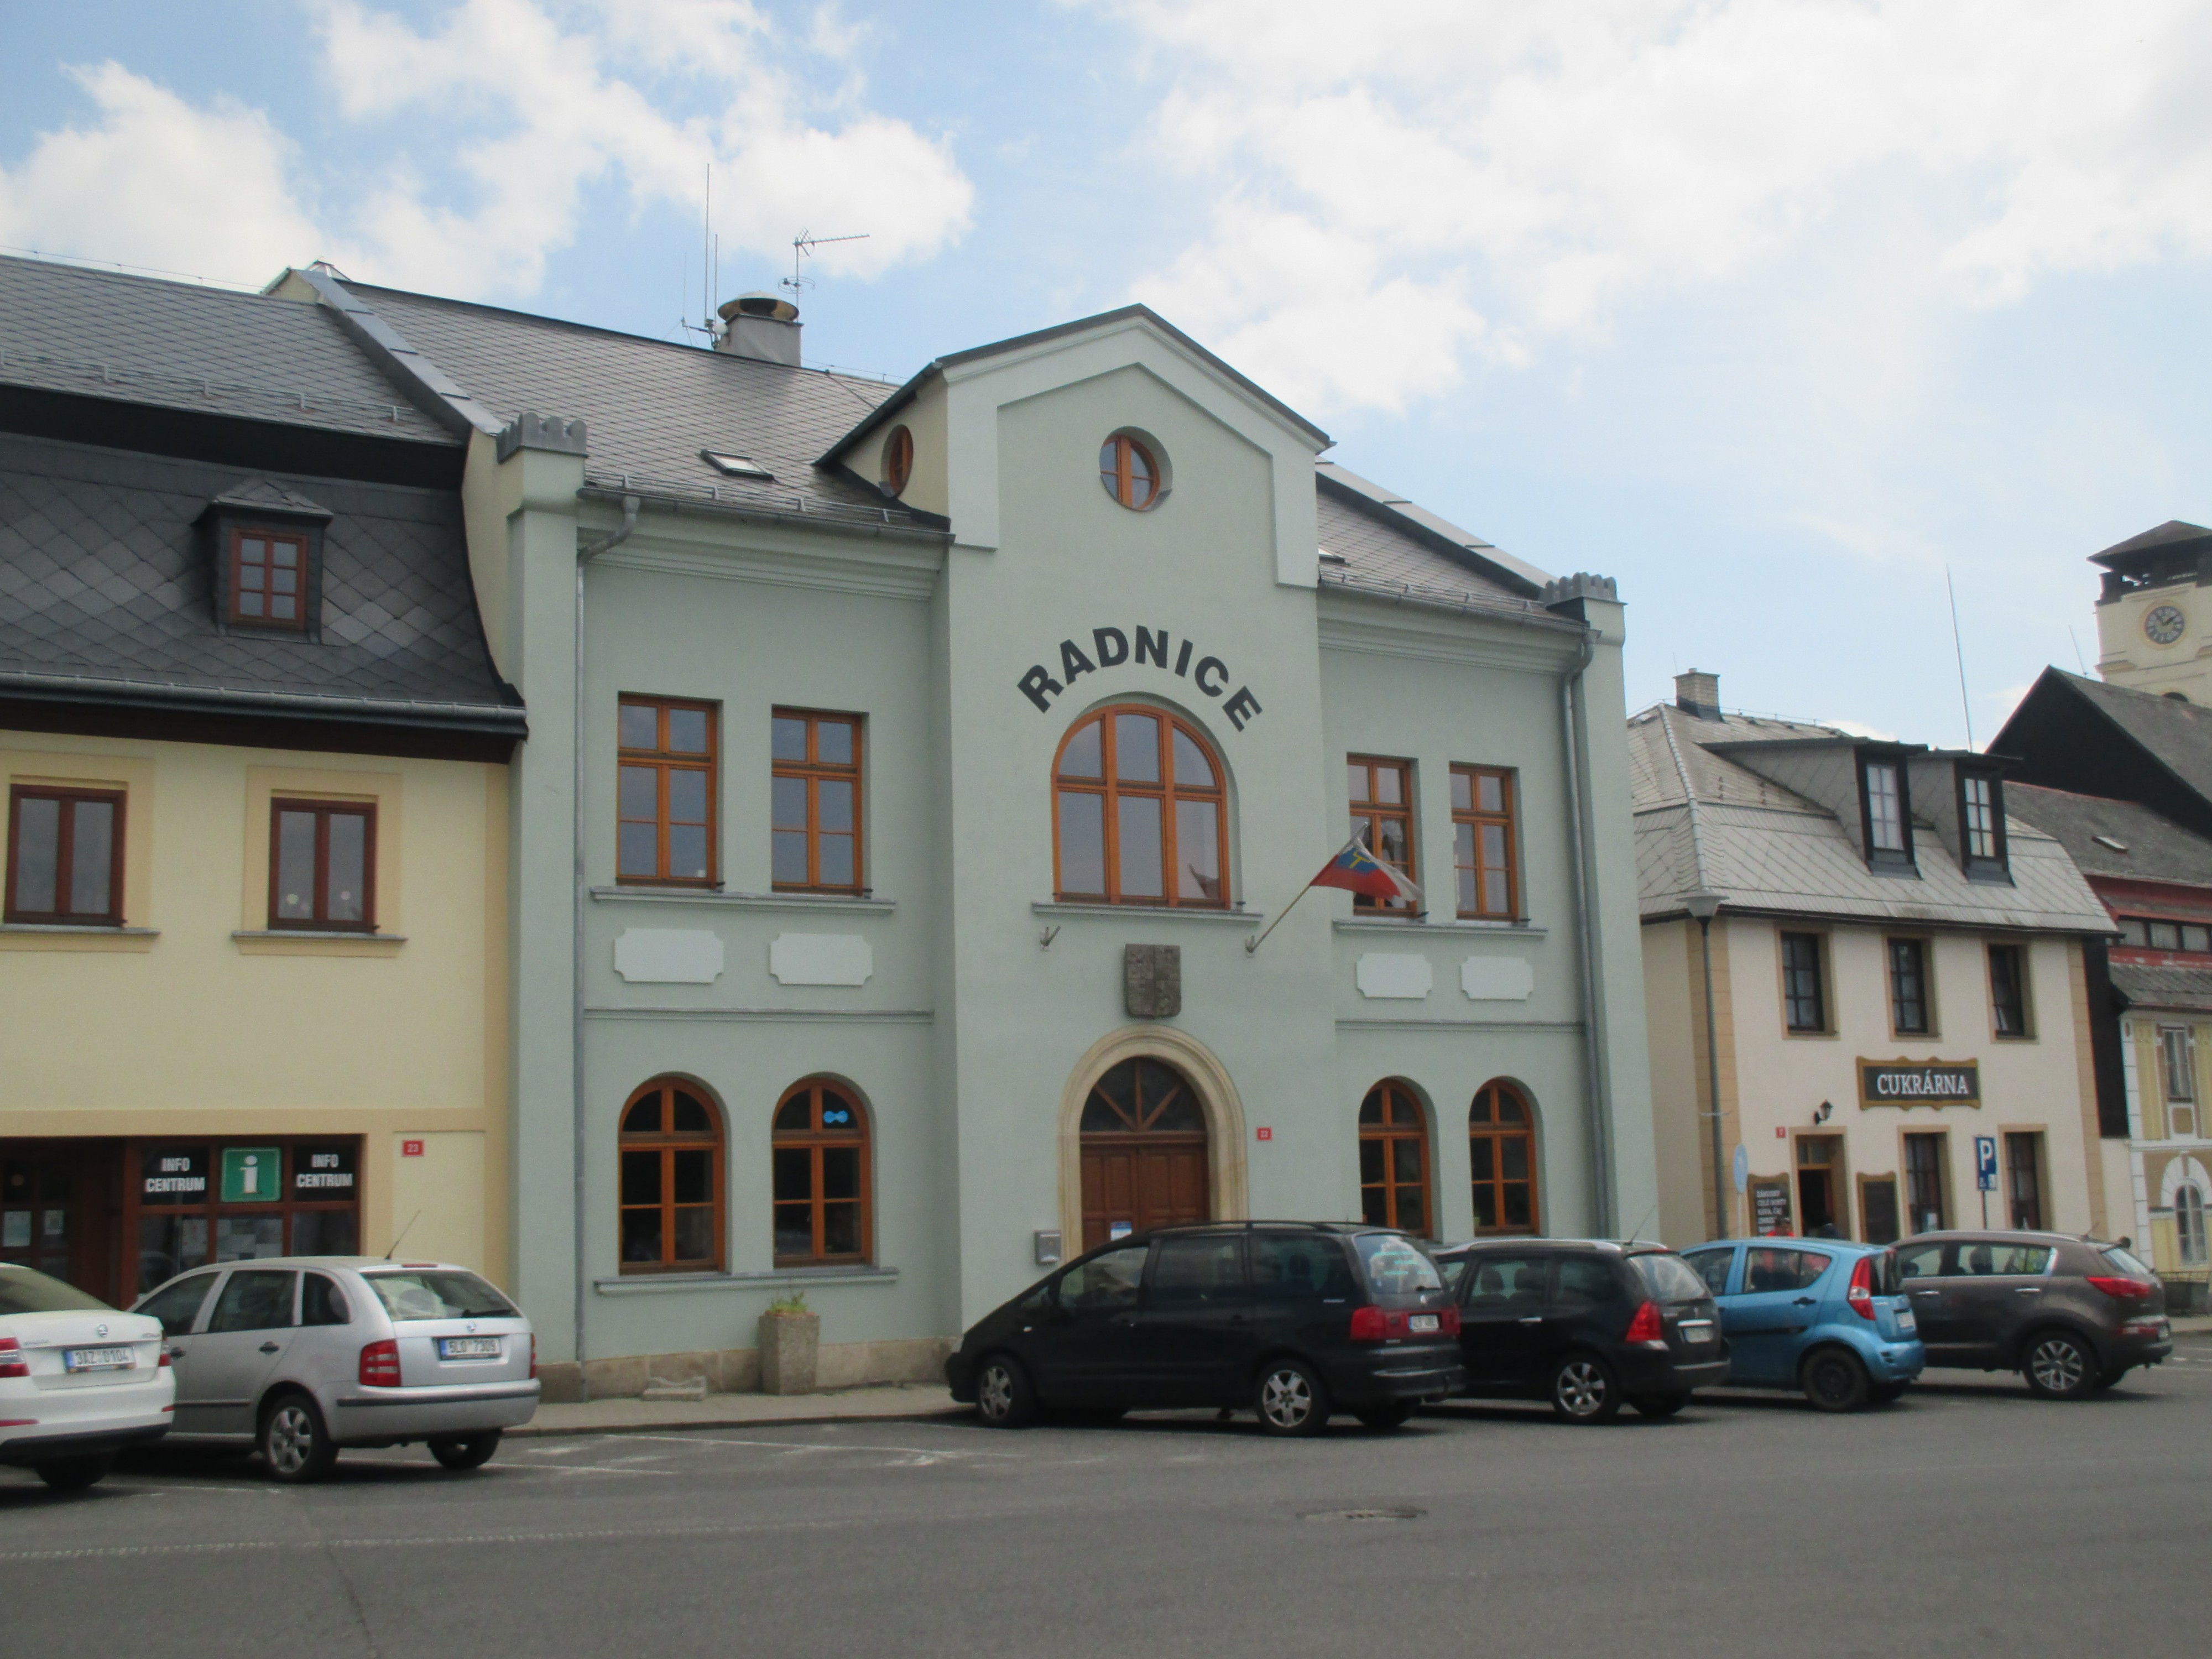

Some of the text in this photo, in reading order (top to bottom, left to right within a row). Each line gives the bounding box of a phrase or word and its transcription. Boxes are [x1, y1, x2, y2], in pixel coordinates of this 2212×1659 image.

[1017, 624, 1263, 733] RADNICE
[1877, 1069, 1969, 1094] CUKRÁRNA
[311, 1154, 339, 1168] INFO
[1979, 1140, 1993, 1171] P
[161, 1157, 190, 1172] INFO
[145, 1177, 205, 1192] CENTRUM
[296, 1173, 353, 1187] CENTRUM
